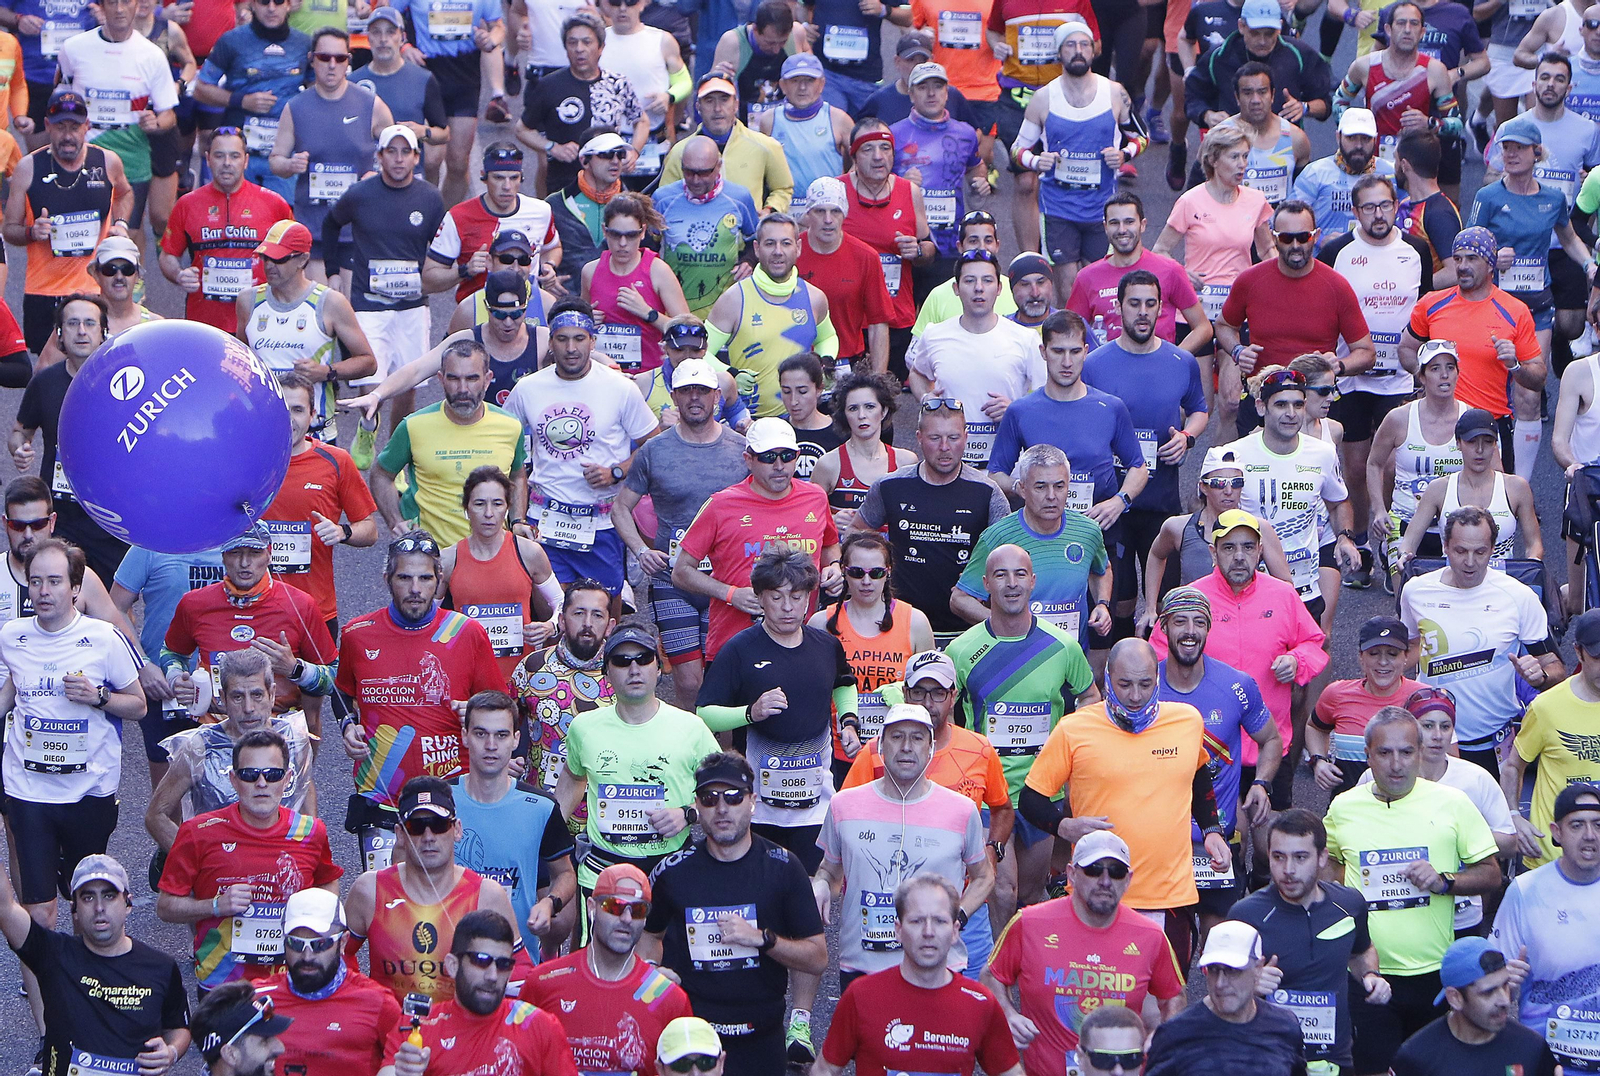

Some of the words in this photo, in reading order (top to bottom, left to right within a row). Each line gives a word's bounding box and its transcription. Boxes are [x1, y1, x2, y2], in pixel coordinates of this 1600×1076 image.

[952, 12, 978, 20] ZURICH
[1031, 27, 1055, 35] ZURIC
[98, 90, 126, 100] ZURICH
[260, 119, 279, 128] ZURIC
[1069, 151, 1096, 160] ZURICH
[324, 165, 353, 173] ZURICH
[1258, 168, 1284, 178] ZURICH
[1545, 171, 1571, 180] ZURICH
[324, 178, 343, 188] 9004
[927, 189, 952, 197] ZURICH
[925, 203, 946, 212] 10434
[63, 212, 94, 223] ZURICH
[65, 230, 90, 240] 10942
[201, 227, 223, 239] Bar
[225, 225, 257, 238] Colón
[676, 252, 727, 264] VENTURA
[1351, 255, 1368, 266] edp
[1515, 257, 1541, 267] ZURICH
[217, 259, 246, 268] ZURICH
[215, 275, 239, 285] 10080
[385, 281, 409, 289] 11654
[1372, 279, 1397, 291] edp
[1099, 286, 1119, 298] CARRE
[1212, 287, 1231, 296] ZURI
[607, 326, 636, 335] ZURICH
[1371, 333, 1396, 343] URICH
[254, 337, 305, 352] Chipiona
[603, 341, 627, 351] 11467
[116, 367, 197, 454] ZURICH
[964, 424, 995, 434] ZURICH
[966, 442, 988, 450] 1660
[1434, 458, 1463, 466] CARROS
[1069, 472, 1088, 482] RICH
[1281, 481, 1314, 491] CARROS
[1281, 491, 1292, 500] DE
[559, 503, 592, 516] ZURICH
[1281, 501, 1308, 510] FUEGO
[270, 523, 305, 533] ZURICH
[555, 519, 582, 530] 10180
[775, 524, 788, 535] edp
[909, 522, 941, 532] ZURICH
[554, 530, 577, 540] SERGIO
[272, 541, 296, 552] 0219
[744, 538, 818, 558] MARID
[271, 555, 289, 563] HUGO
[904, 555, 926, 564] ZURICH
[1285, 550, 1307, 562] URICH
[188, 565, 225, 581] RUN
[481, 606, 516, 617] ZURICH
[1044, 602, 1075, 612] ZURICH
[485, 625, 509, 635] 1492
[491, 638, 509, 646] RDES
[845, 650, 903, 663] LAPHAM
[917, 651, 942, 664] NIKE
[43, 663, 58, 673] edp
[1432, 660, 1463, 675] MARATÓ
[1454, 669, 1477, 681] SANTA
[1477, 664, 1494, 676] POLA
[361, 684, 415, 696] ASOCIACIÓN
[362, 695, 389, 705] MARCO
[390, 695, 416, 704] LUNA
[858, 696, 885, 705] ZURIC
[1008, 704, 1045, 715] ZURICH
[860, 714, 885, 724] 1468
[40, 720, 81, 733] ZURICH
[1007, 724, 1033, 734] 9750
[858, 727, 880, 737] RACY
[42, 740, 69, 751] 9950
[1011, 737, 1027, 745] PITU
[1151, 746, 1178, 756] enjoy!
[44, 754, 65, 764] DIEGO
[782, 757, 817, 769] ZURICH
[781, 777, 807, 788] 9086
[619, 787, 658, 798] ZURICH
[771, 790, 807, 799] GREGORIO
[808, 789, 814, 797] J.
[618, 809, 644, 819] 9151
[612, 823, 649, 832] PORRITAS
[858, 831, 876, 844] edp
[1381, 850, 1421, 863] ZURICH
[481, 873, 504, 884] RICH
[1194, 870, 1216, 878] ARTIN
[1382, 873, 1407, 884] 935
[249, 892, 268, 901] UNA
[1381, 887, 1411, 898] FERLOS
[257, 907, 285, 917] ZURI
[876, 914, 898, 925] 123
[255, 928, 282, 939] 8762
[707, 933, 722, 944] 99
[866, 930, 896, 939] LUISMA
[256, 940, 278, 952] IÑAKI
[710, 948, 734, 958] NANA
[1086, 953, 1102, 963] edp
[382, 959, 450, 980] DUQU
[1044, 966, 1137, 993] MADRID
[409, 979, 455, 991] ACACIA
[101, 985, 152, 998] marathon
[1055, 986, 1127, 999] MARATHON
[1289, 993, 1329, 1005] ZURICH
[1572, 1010, 1600, 1020] ZURIC
[1298, 1016, 1319, 1027] 750
[1565, 1027, 1600, 1040] 13747
[923, 1030, 970, 1048] Berenloop
[573, 1046, 610, 1058] IACIÓN
[1548, 1042, 1600, 1058] @ALEJANDRO
[93, 1057, 135, 1073] ZURICH
[582, 1058, 609, 1068] LUNA
